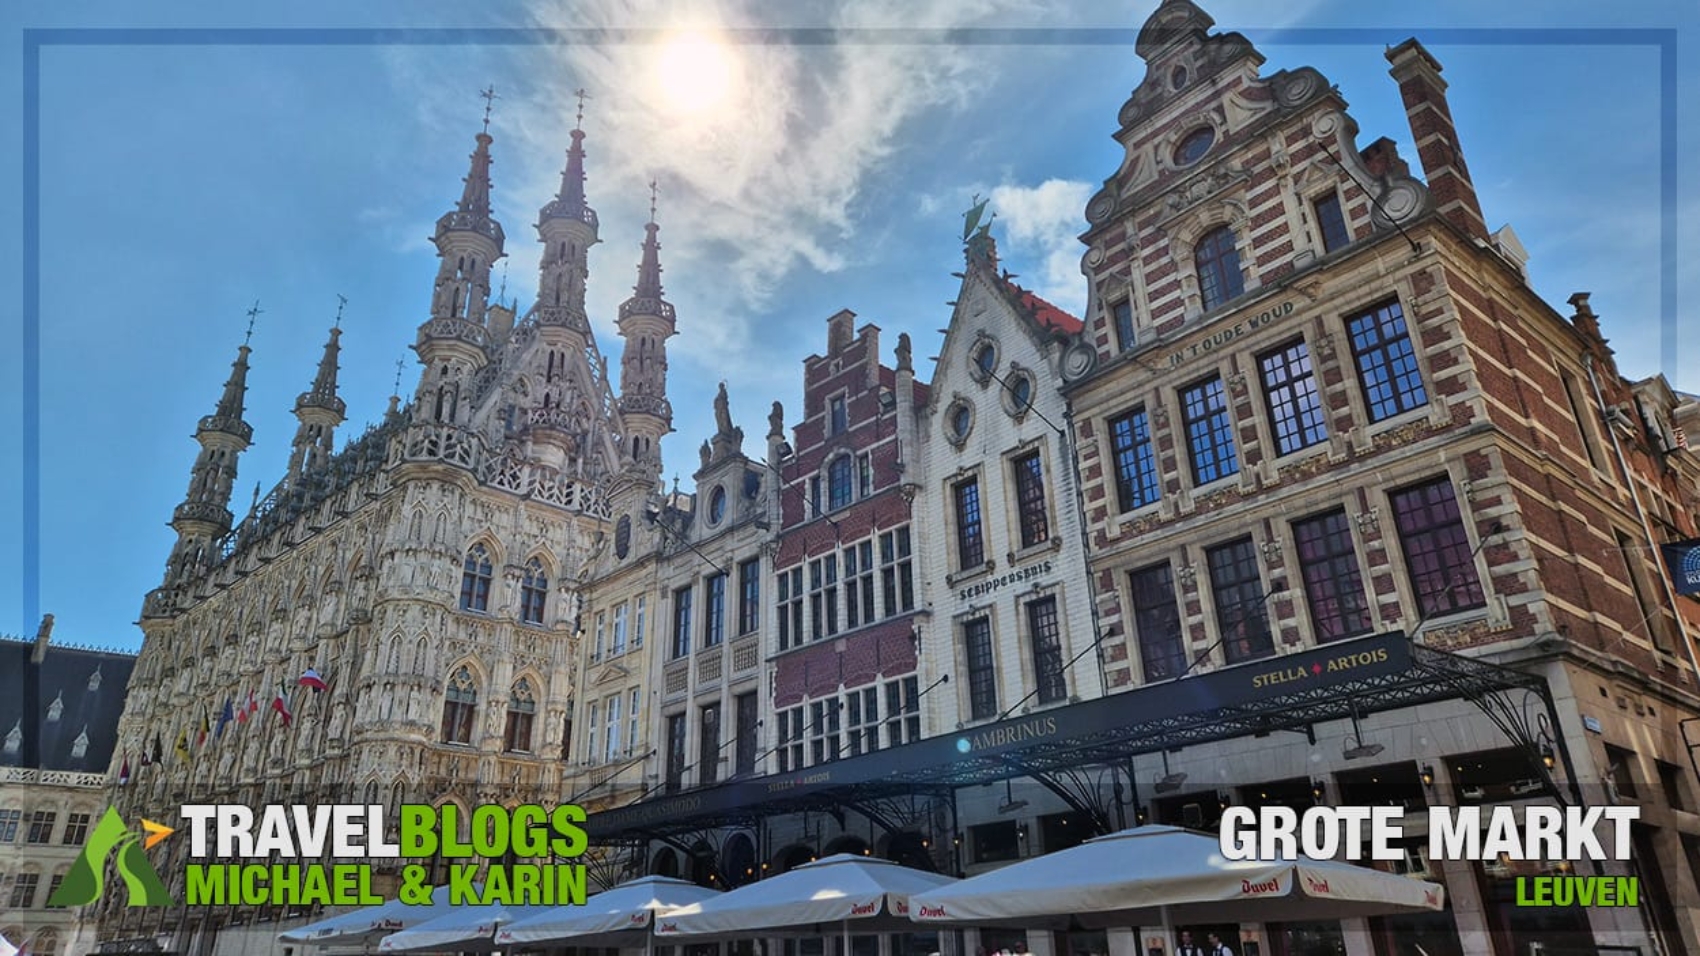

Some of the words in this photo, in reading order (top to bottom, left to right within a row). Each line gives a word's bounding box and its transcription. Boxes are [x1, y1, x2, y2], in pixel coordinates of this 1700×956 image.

[1169, 352, 1184, 366] IN
[1202, 323, 1244, 351] OUDE
[1248, 301, 1294, 330] WOUD
[1252, 666, 1308, 688] STELLA
[1327, 648, 1388, 673] ARTOIS
[958, 717, 1056, 753] AMBRINUS
[1241, 877, 1279, 894] Duvel
